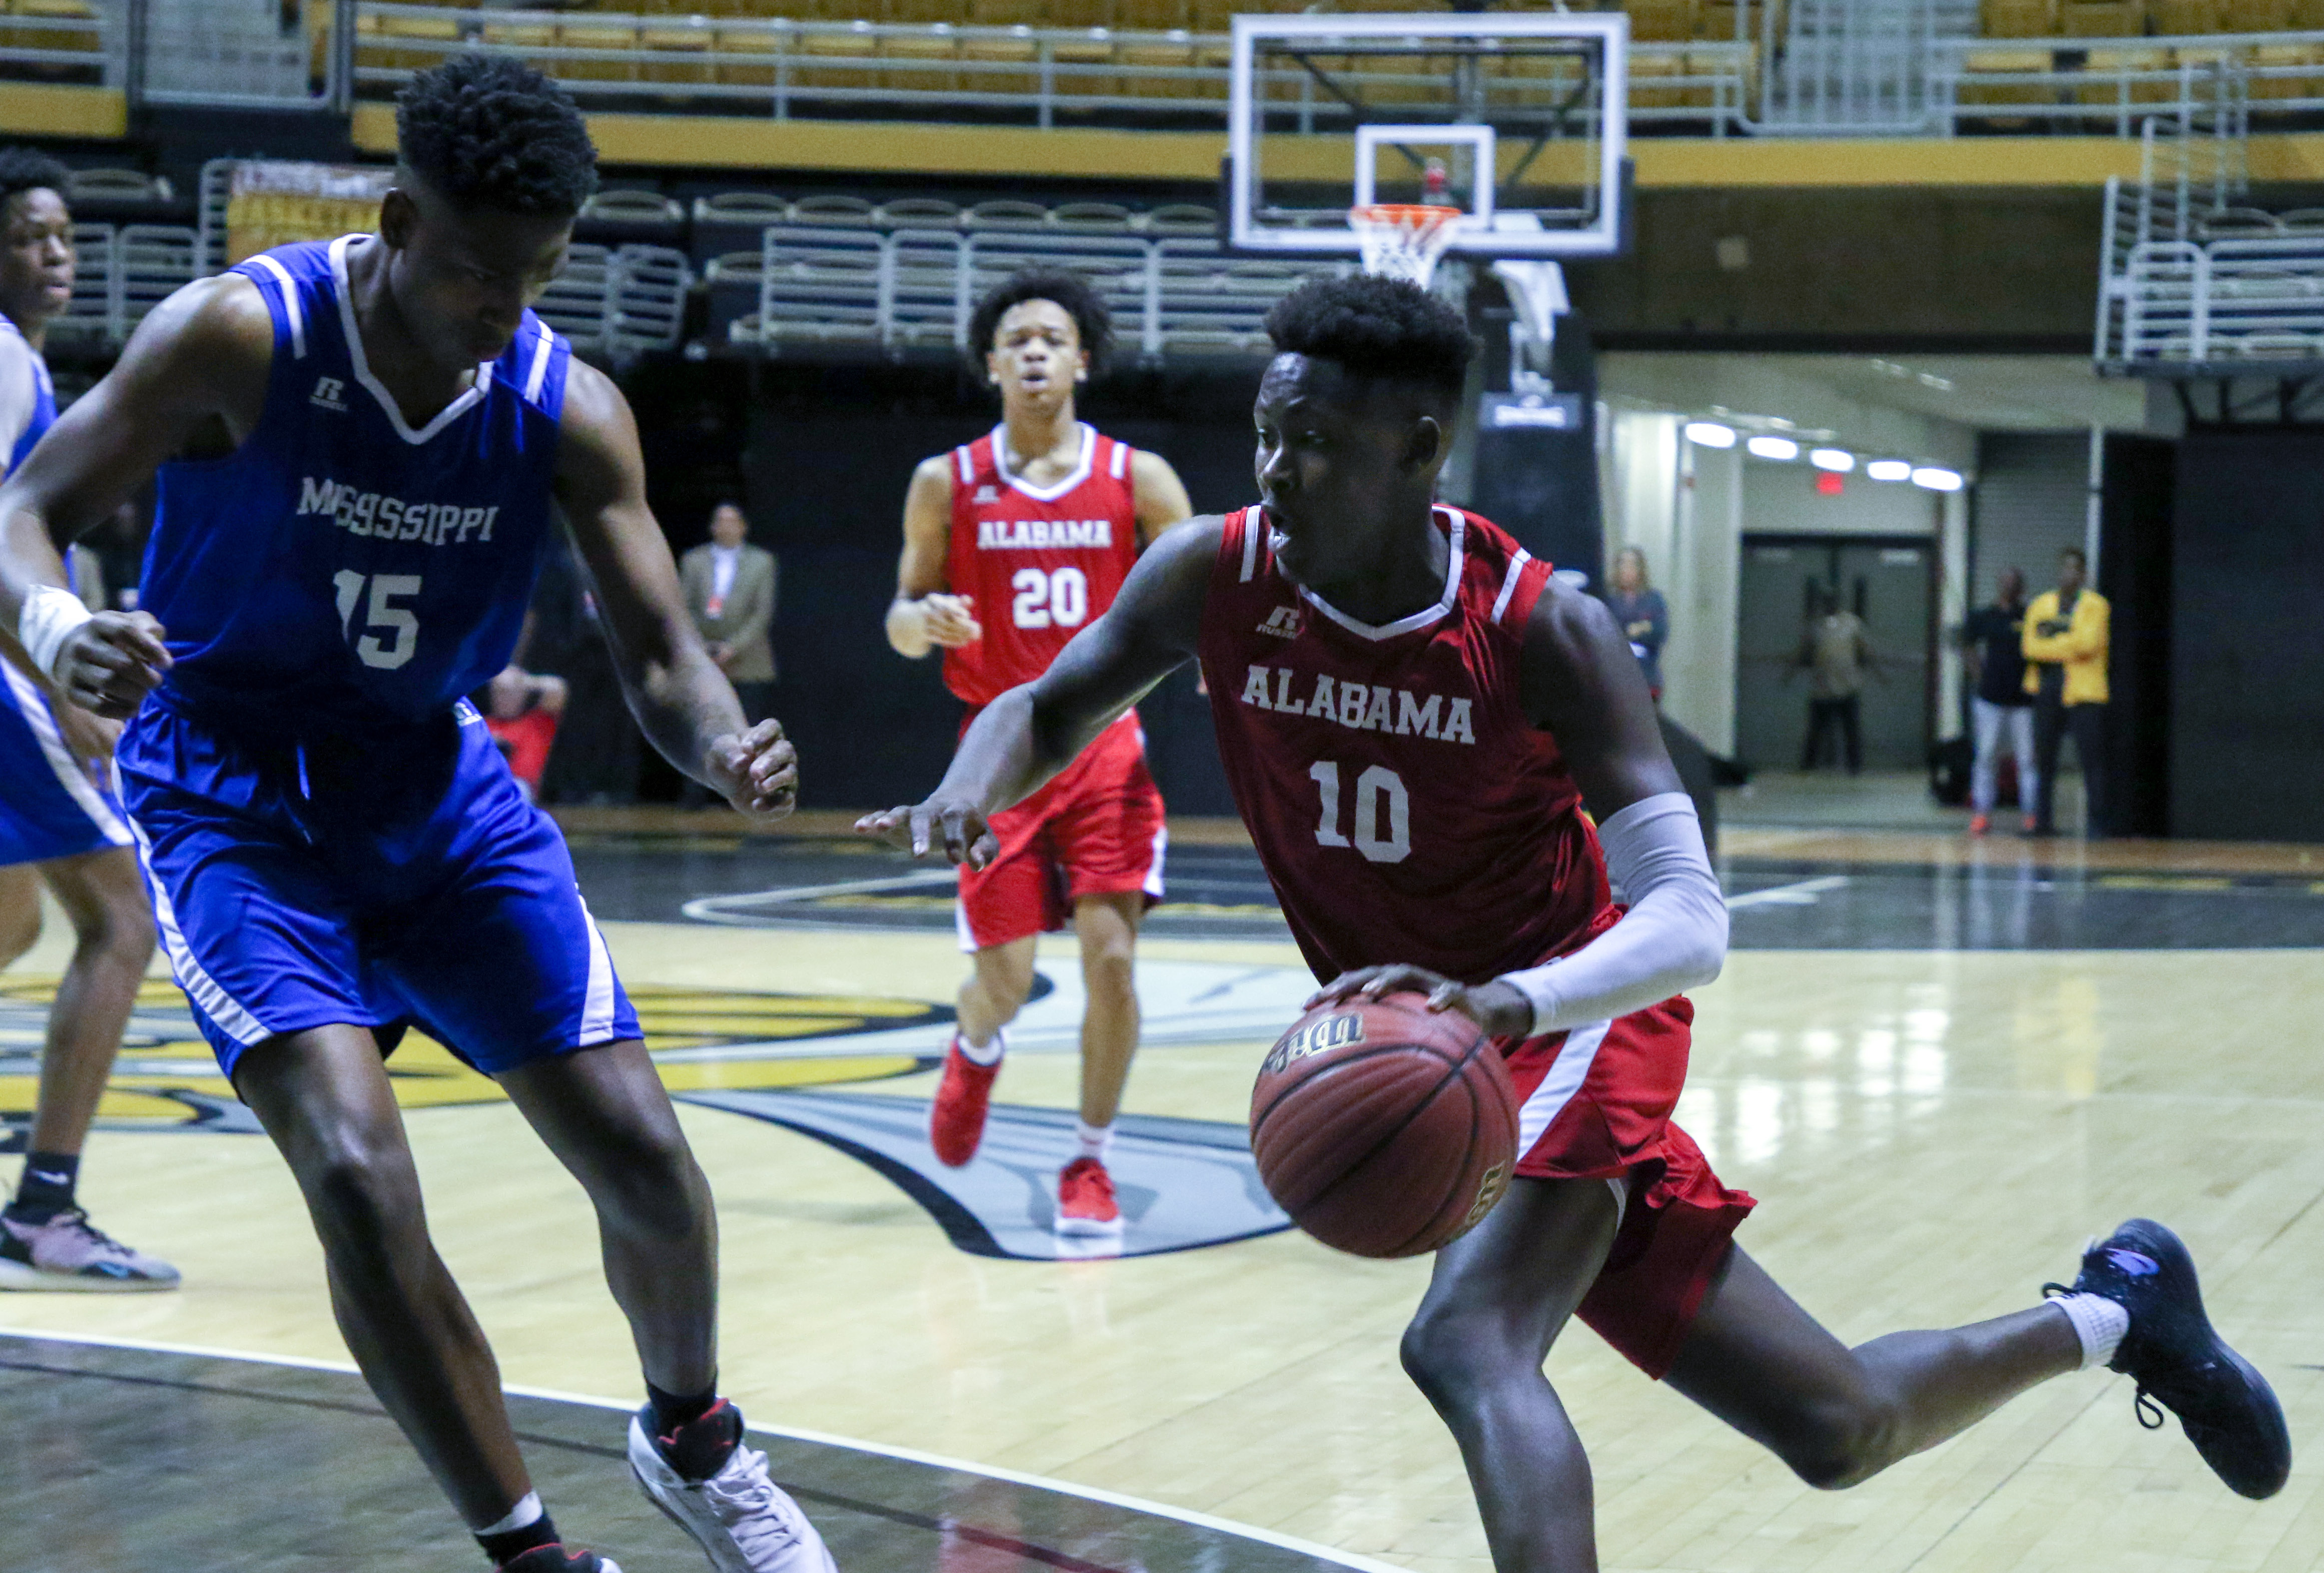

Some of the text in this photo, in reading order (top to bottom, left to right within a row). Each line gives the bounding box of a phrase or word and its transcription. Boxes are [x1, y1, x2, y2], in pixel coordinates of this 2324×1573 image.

[977, 519, 1112, 550] ALABAMA
[333, 569, 422, 670] 15
[1011, 566, 1087, 629] 20
[1241, 664, 1476, 745] ALABAMA
[1309, 760, 1411, 863] 10
